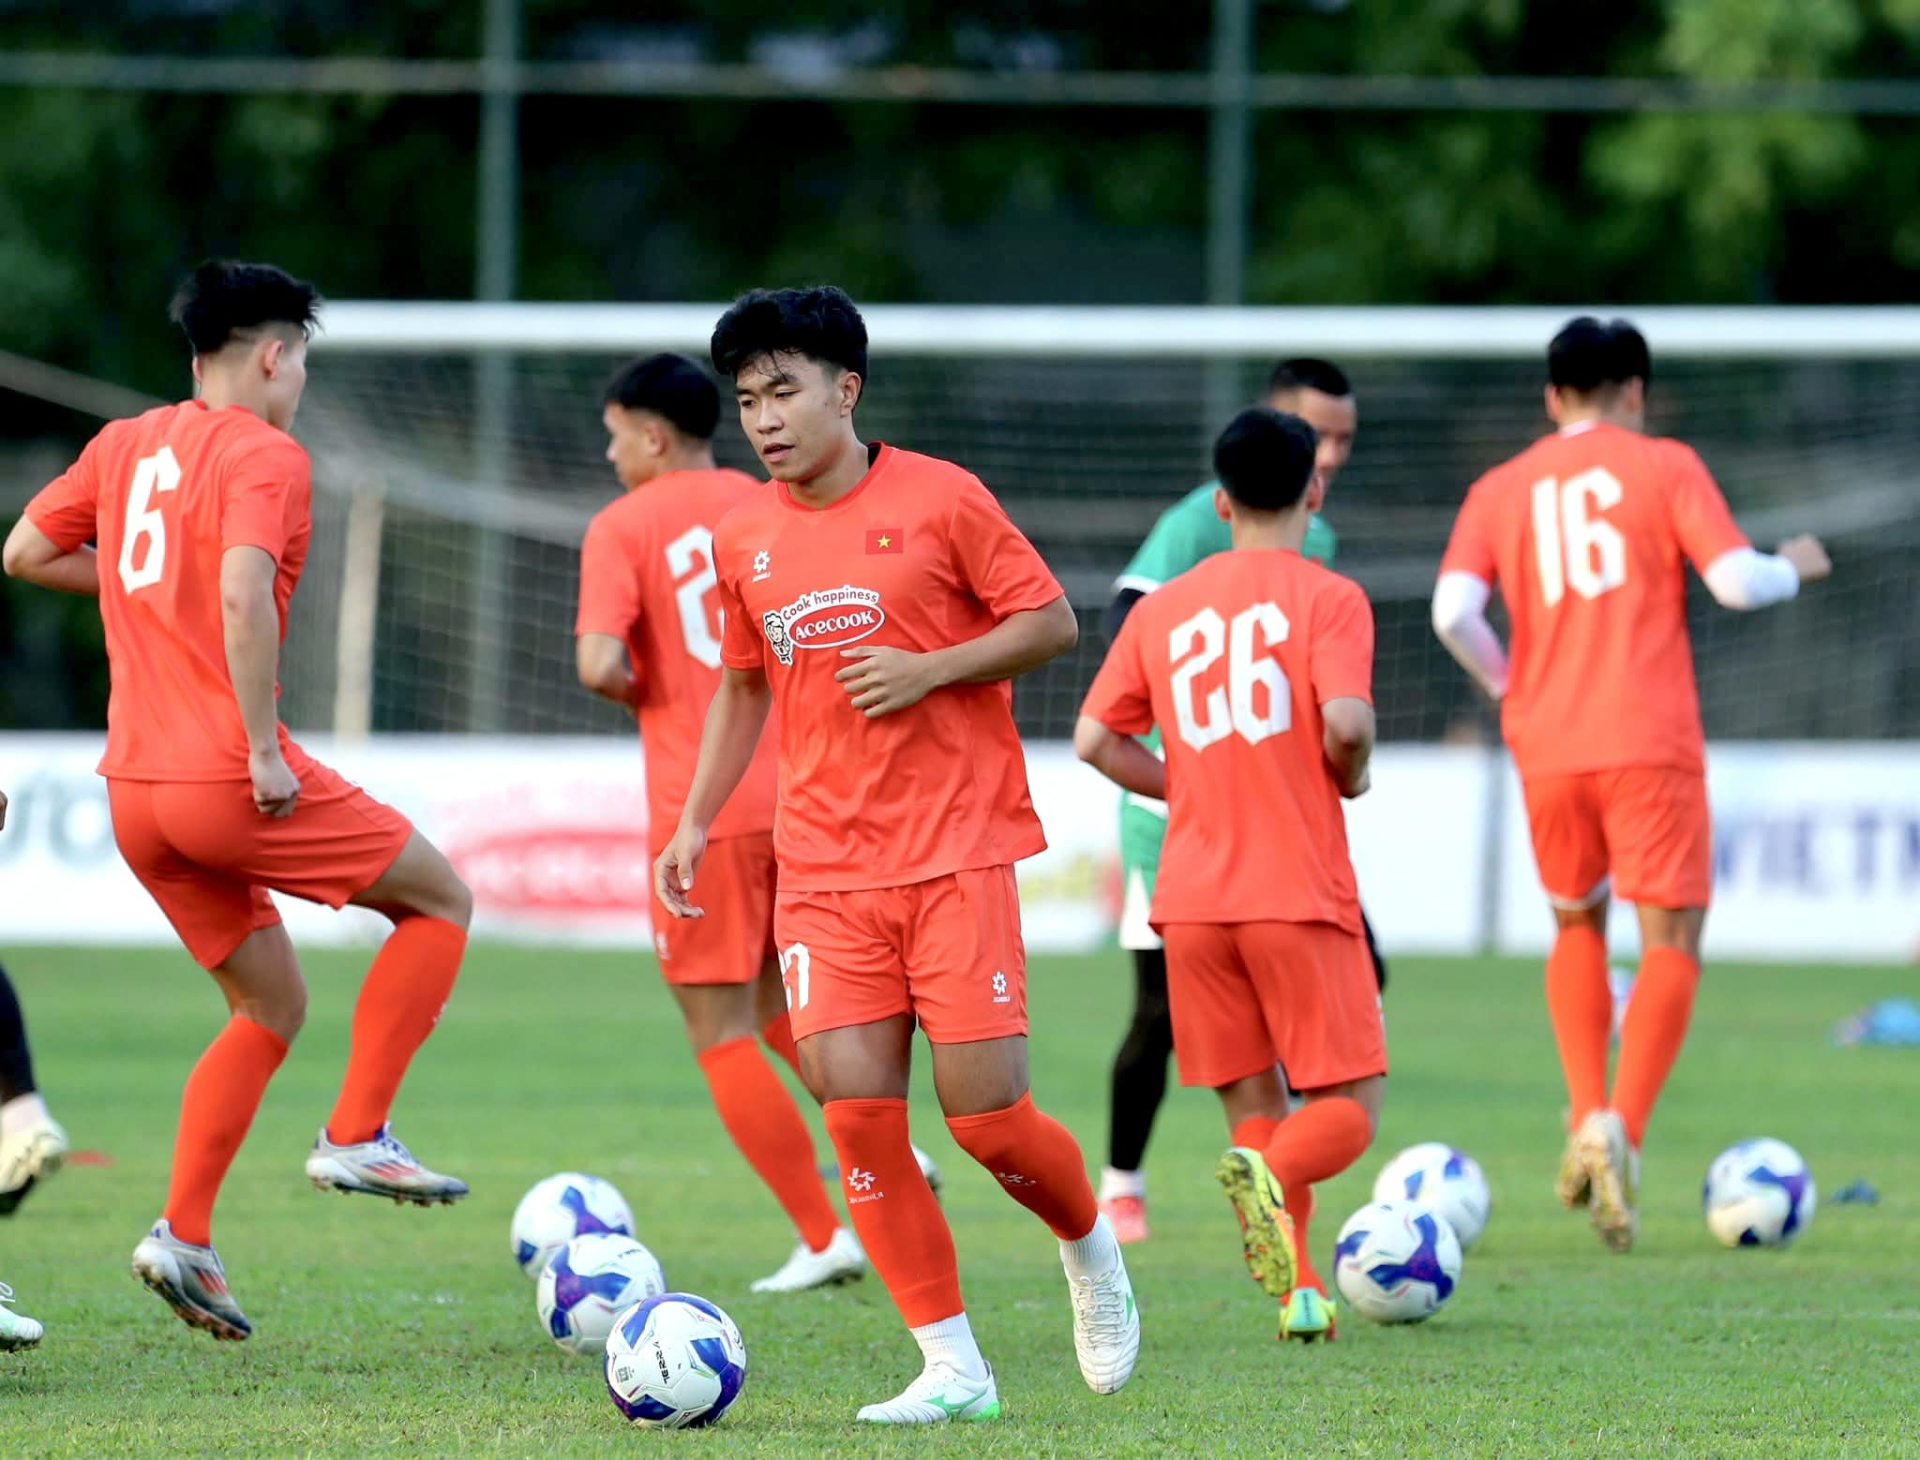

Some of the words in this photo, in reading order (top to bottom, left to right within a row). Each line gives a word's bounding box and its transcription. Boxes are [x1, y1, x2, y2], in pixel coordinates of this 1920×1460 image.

[118, 446, 182, 595] 6
[1531, 466, 1626, 609] 16
[782, 598, 811, 620] Cook
[814, 587, 877, 604] happiness
[1169, 600, 1292, 754] 26
